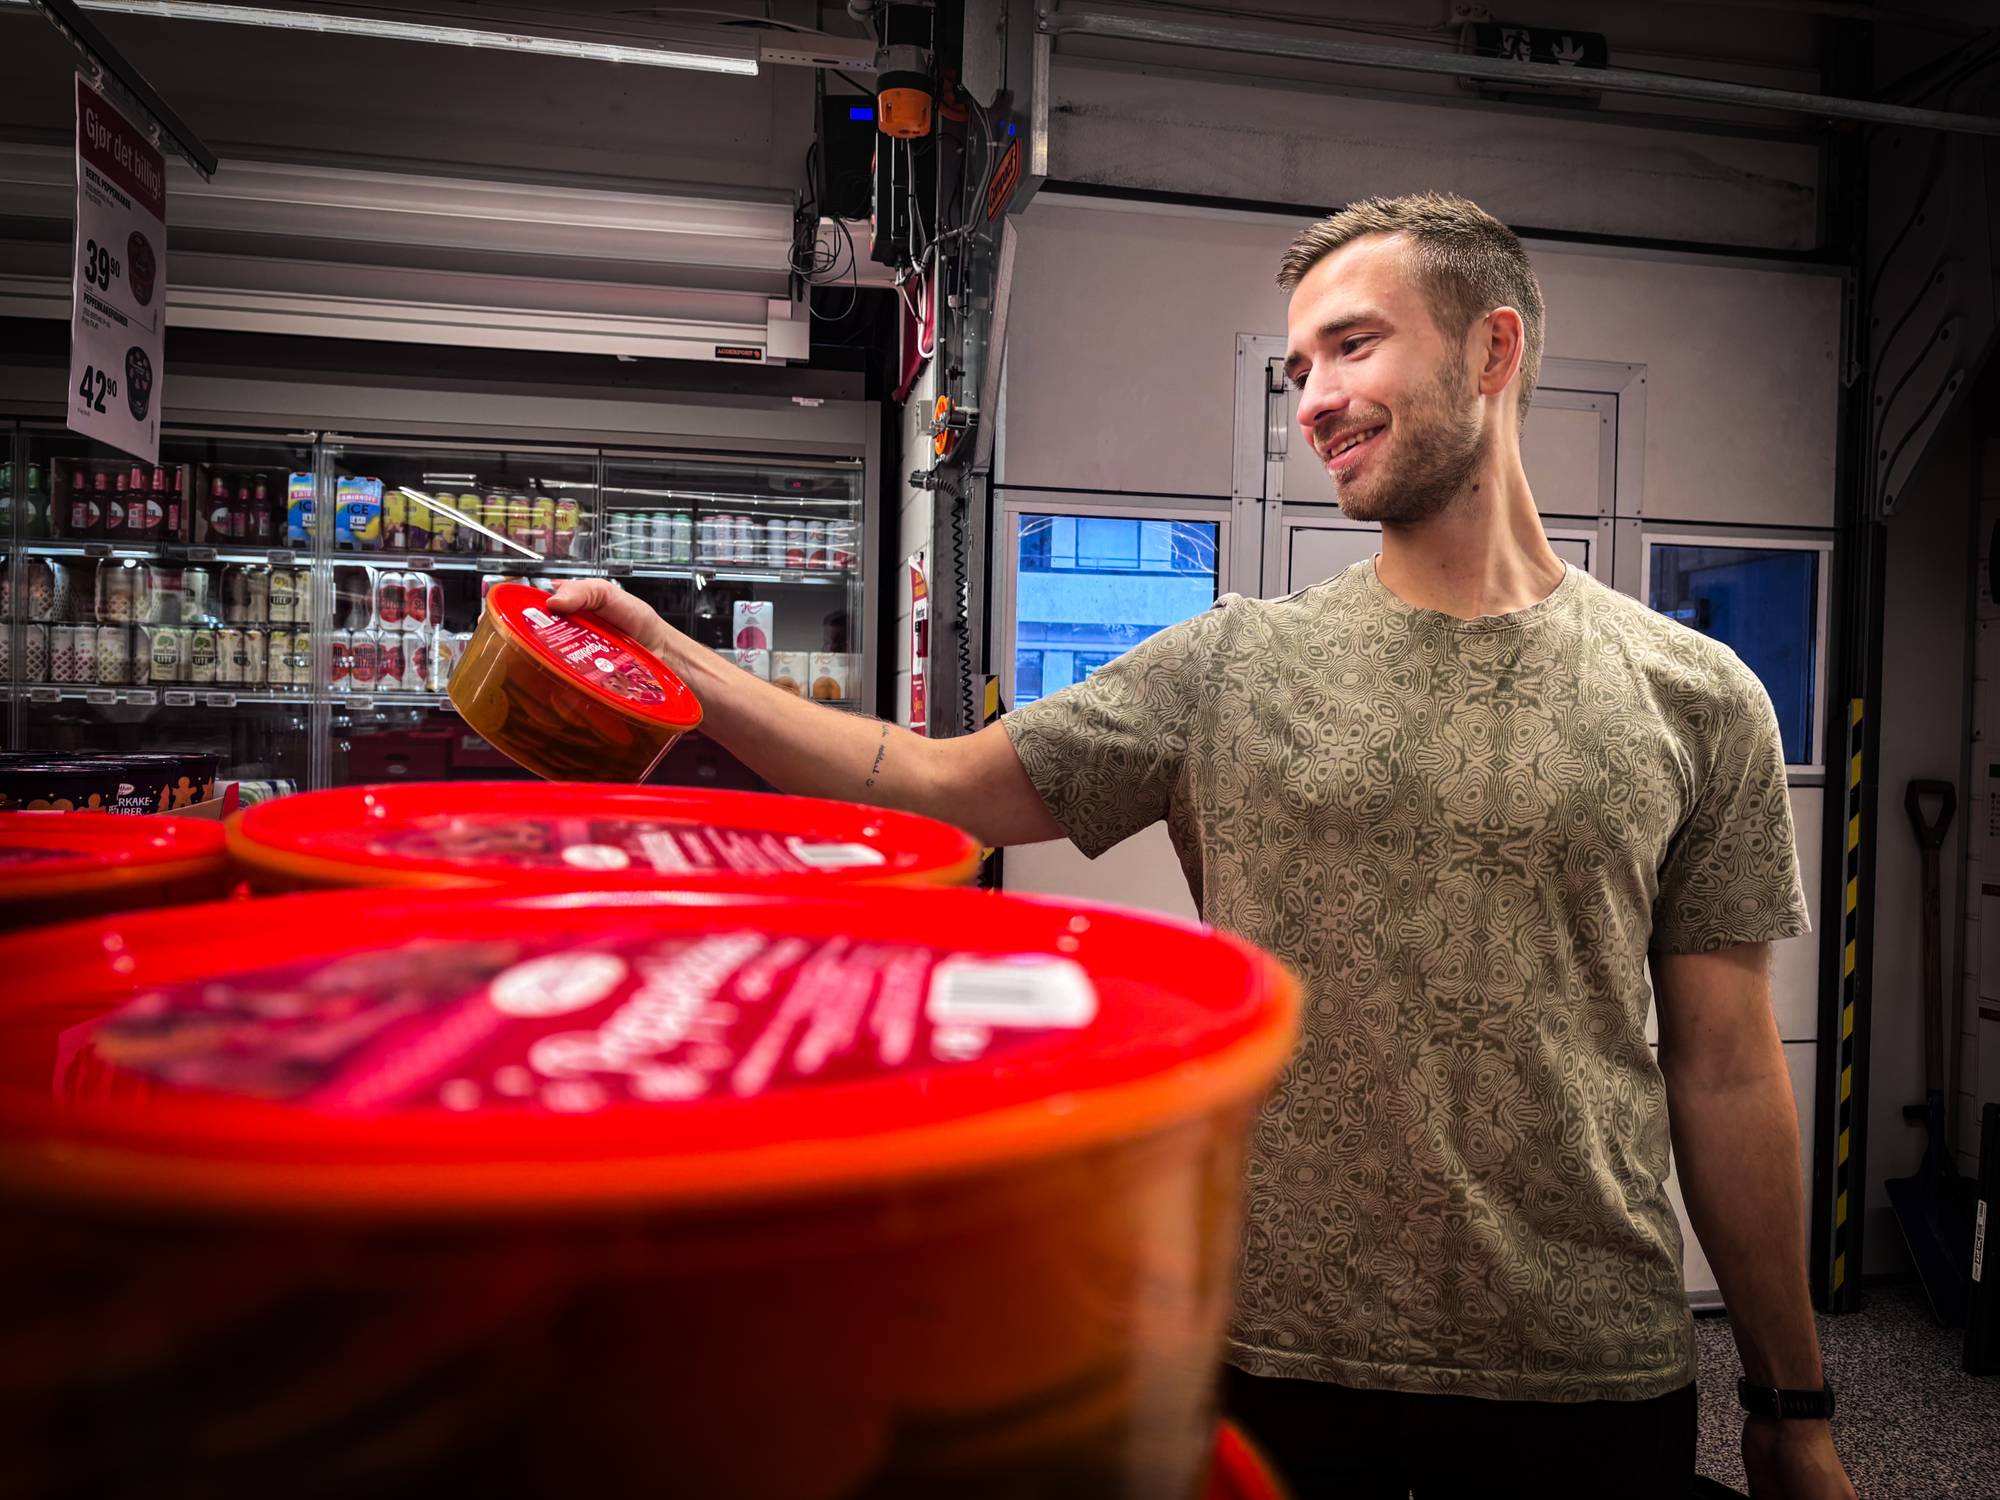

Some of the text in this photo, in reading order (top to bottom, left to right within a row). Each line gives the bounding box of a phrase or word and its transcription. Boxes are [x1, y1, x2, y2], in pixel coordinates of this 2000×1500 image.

[86, 107, 112, 152] Gjør
[114, 135, 132, 173] det
[134, 151, 161, 200] billig!
[346, 502, 369, 515] ICE
